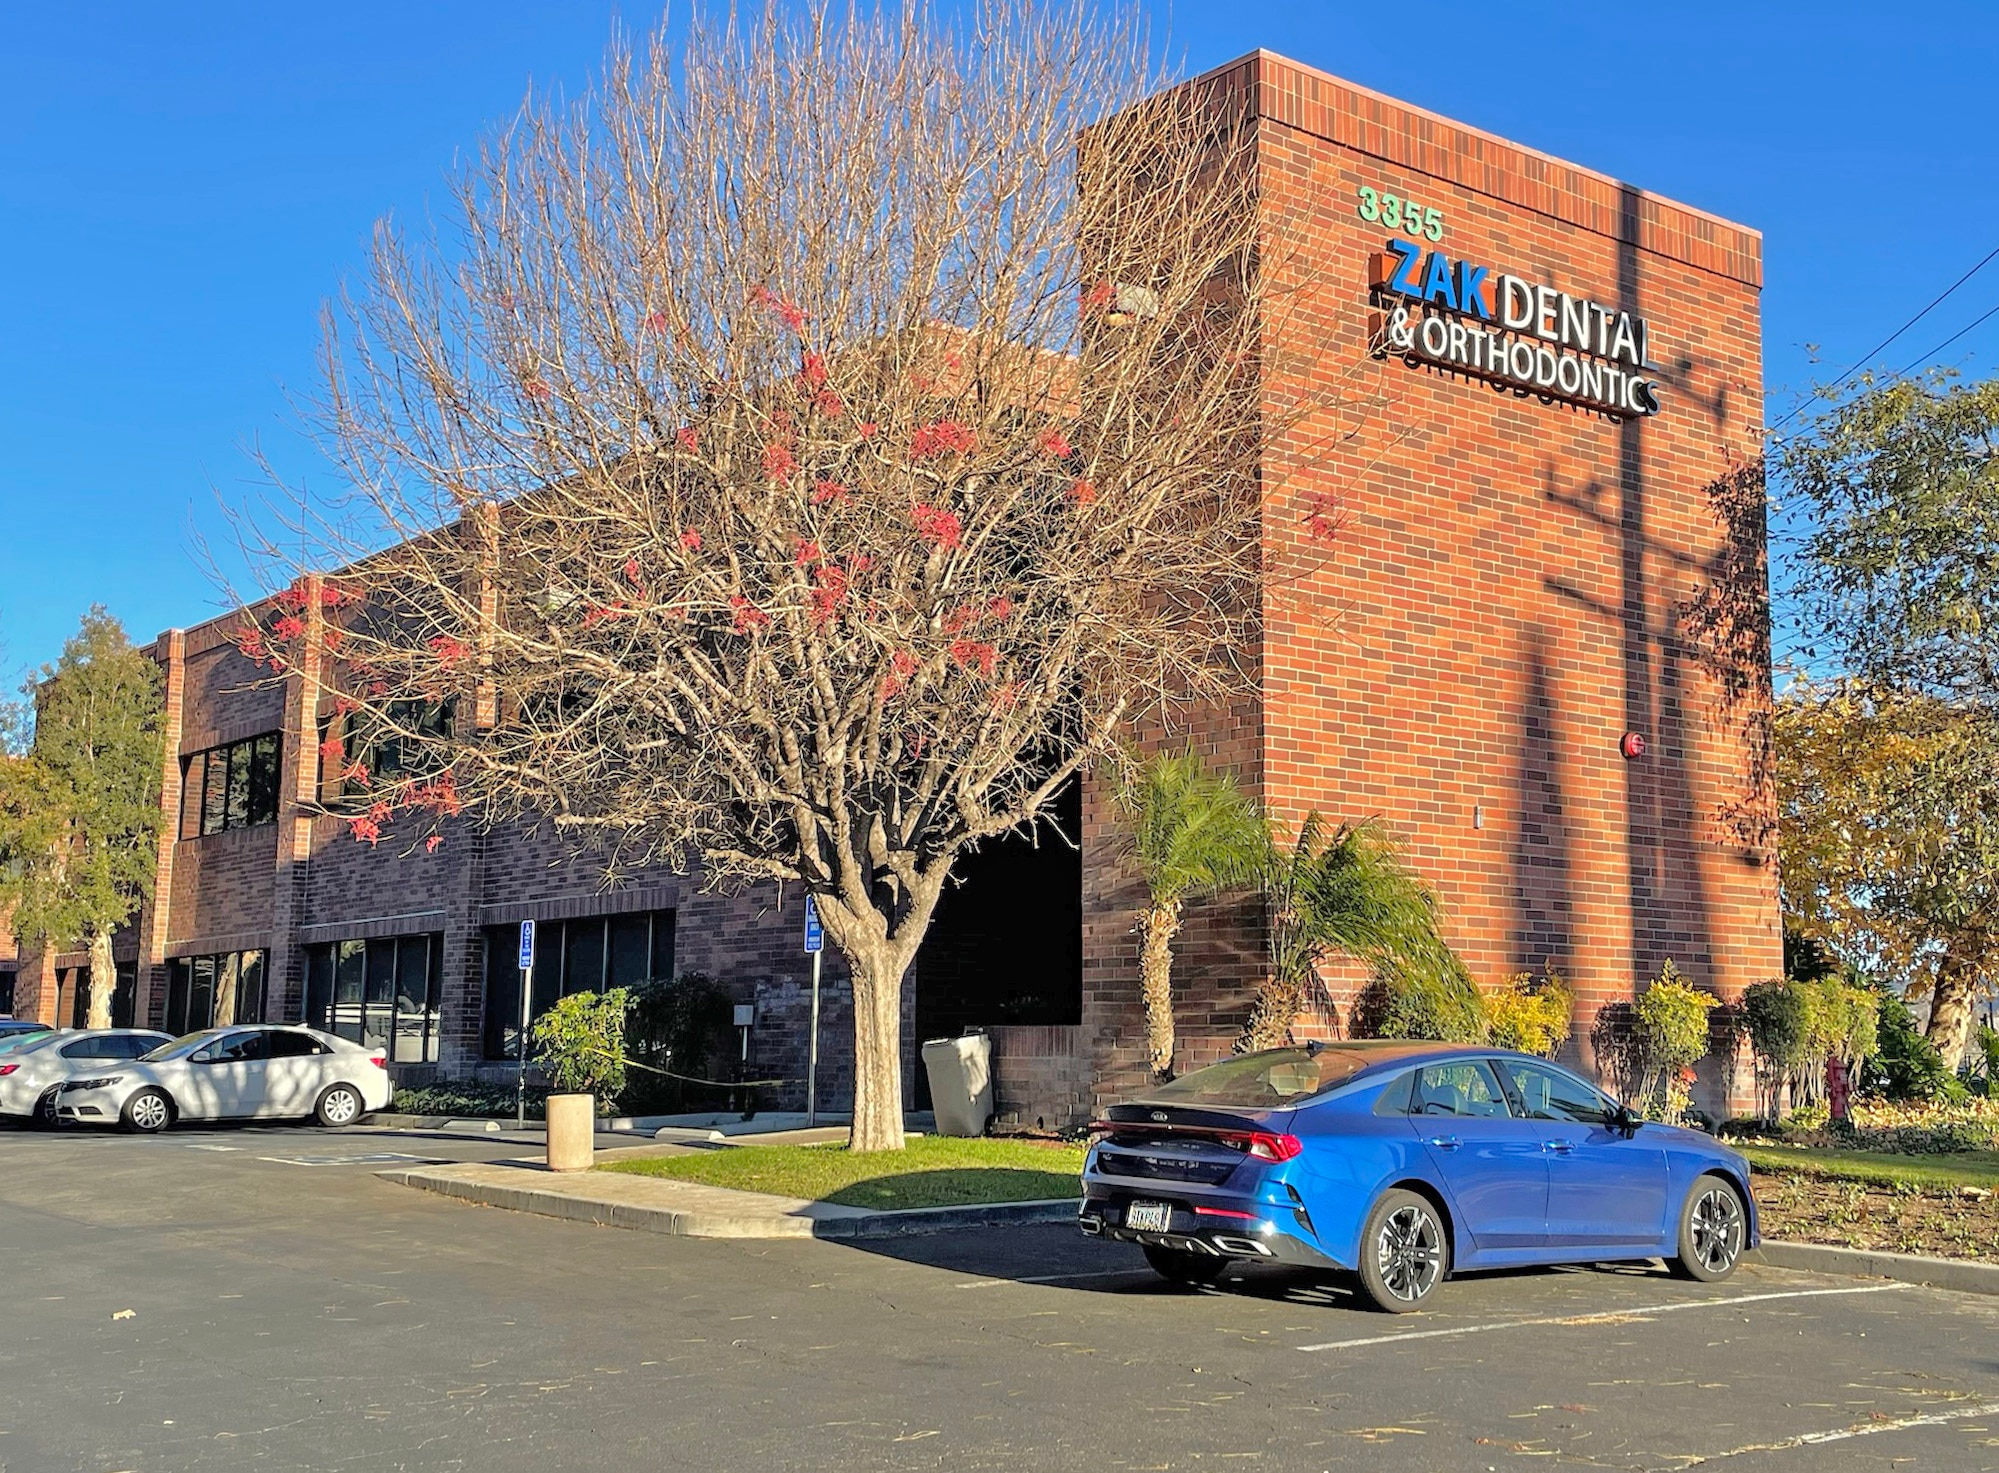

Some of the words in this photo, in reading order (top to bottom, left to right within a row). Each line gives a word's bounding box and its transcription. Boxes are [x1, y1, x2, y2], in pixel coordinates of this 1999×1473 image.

[1358, 186, 1443, 242] 3355
[1388, 238, 1491, 319] ZAK
[1501, 274, 1659, 372] DENTAL
[1391, 307, 1415, 348] &
[1421, 316, 1661, 415] ORTHODONTICS
